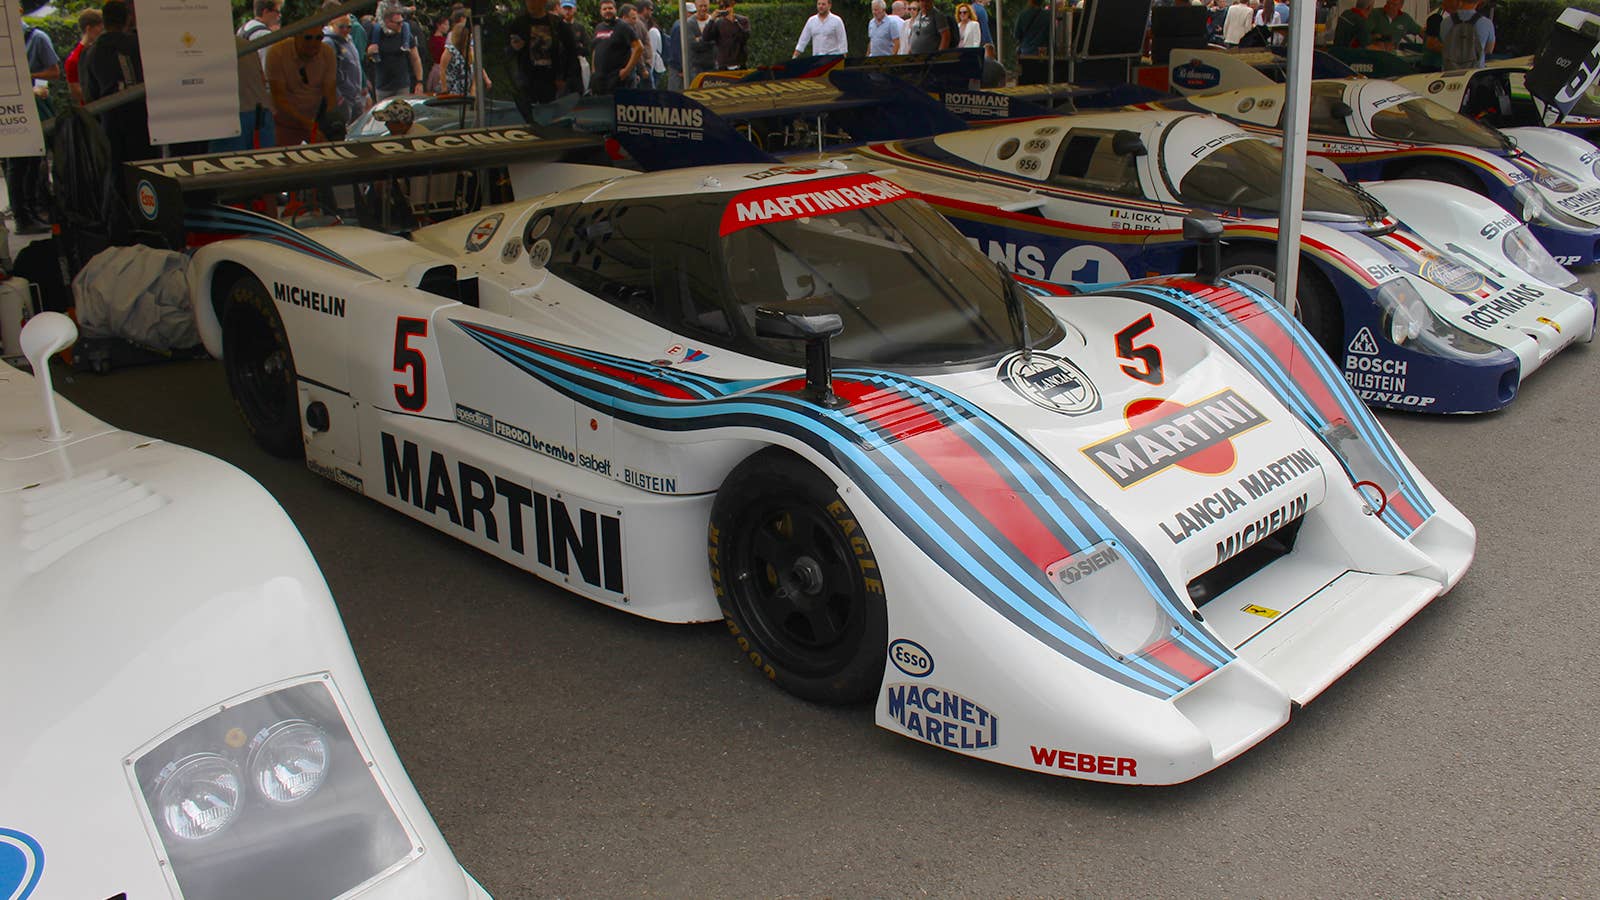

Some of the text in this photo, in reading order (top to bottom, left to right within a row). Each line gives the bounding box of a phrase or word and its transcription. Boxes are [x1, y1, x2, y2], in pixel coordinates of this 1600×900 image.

[616, 104, 704, 127] ROTHMANS
[944, 93, 1010, 107] ROTHMANS
[616, 127, 704, 141] PORSCHE
[1029, 140, 1046, 149] 956
[138, 129, 542, 179] MARTINI RACING
[1019, 159, 1038, 170] 956
[736, 179, 908, 222] MARTINI RACING
[1121, 211, 1161, 224] J. ICKX
[274, 281, 346, 319] MICHELIN
[1461, 283, 1545, 331] ROTHMANS
[393, 315, 428, 413] 5
[1114, 312, 1165, 386] 5
[1345, 355, 1408, 375] BOSCH
[1035, 371, 1076, 392] LANCIA
[1344, 371, 1406, 393] BILSTEIN
[497, 422, 530, 445] FERODO
[532, 435, 576, 463] brembo
[1094, 395, 1258, 480] MARTINI
[579, 454, 612, 477] sabelt
[624, 468, 677, 493] BILSTEIN
[1158, 447, 1321, 545] LANCIA MARTINI
[381, 431, 624, 594] MARTINI
[1215, 493, 1309, 566] MICHELIN
[826, 500, 886, 594] EAGLE
[1077, 547, 1120, 576] SIEM
[887, 684, 998, 735] MAGNETI
[887, 695, 998, 750] MARELLI
[1030, 745, 1138, 778] WEBER
